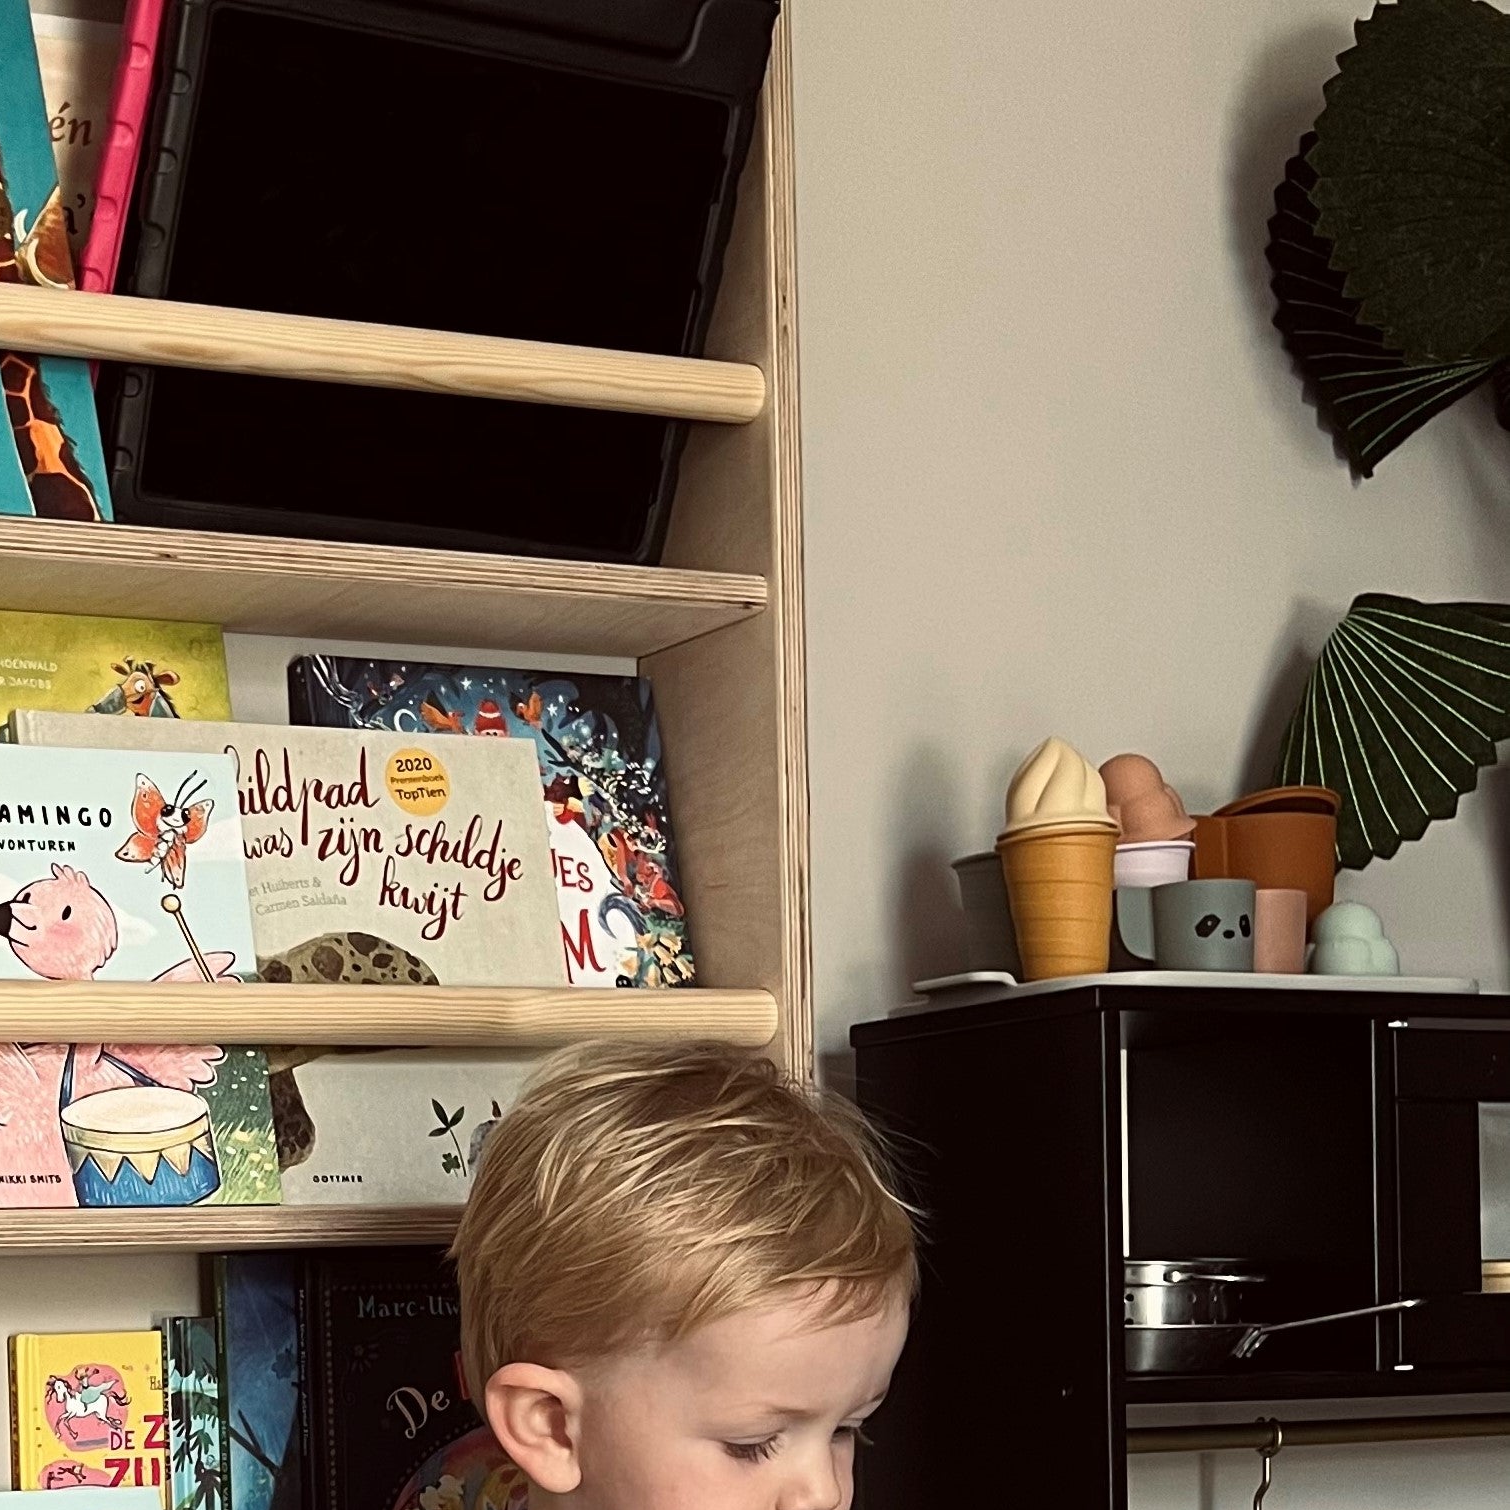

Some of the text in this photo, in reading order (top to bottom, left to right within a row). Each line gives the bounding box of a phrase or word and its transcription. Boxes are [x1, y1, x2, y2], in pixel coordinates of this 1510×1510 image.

[395, 757, 433, 773] 2020
[394, 786, 447, 802] TopTien
[318, 817, 383, 887] zijn
[395, 814, 524, 902] schildje
[312, 876, 322, 888] &
[378, 855, 469, 941] kwijt
[255, 899, 300, 916] Carmen
[30, 1174, 62, 1185] SMITS
[312, 1175, 364, 1184] GOTTMER
[386, 1387, 451, 1440] De
[110, 1430, 135, 1451] DE
